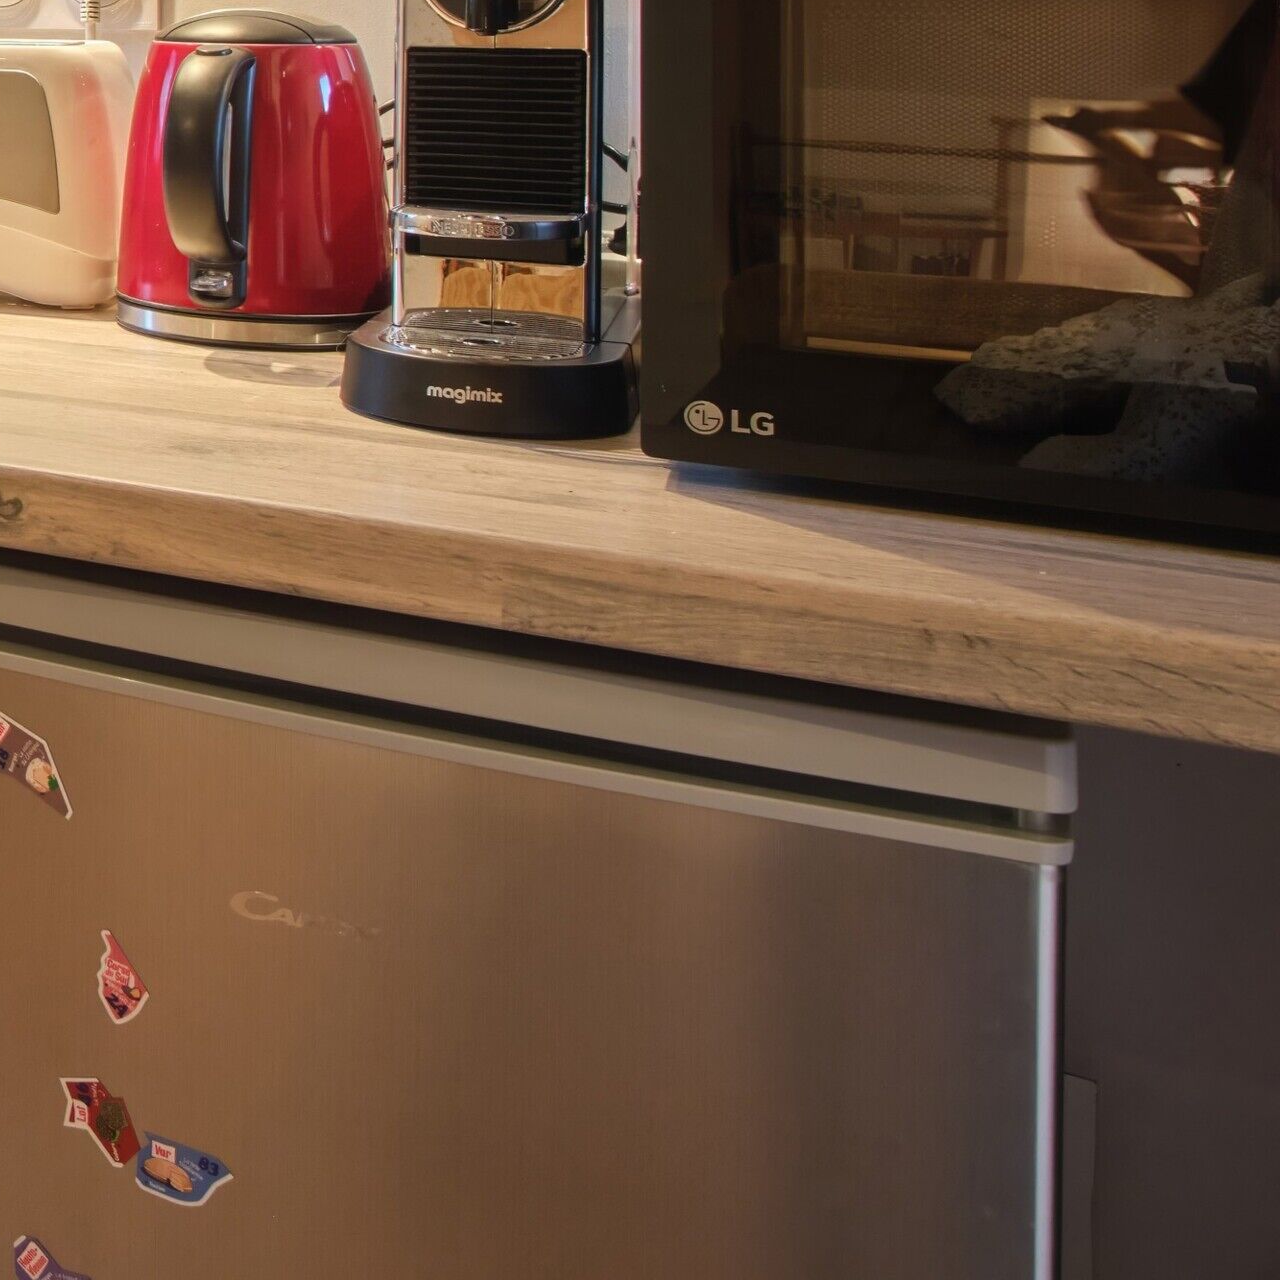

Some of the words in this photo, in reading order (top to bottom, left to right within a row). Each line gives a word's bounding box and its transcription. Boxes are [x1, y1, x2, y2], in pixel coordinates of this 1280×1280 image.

[426, 385, 503, 404] magimix
[731, 409, 775, 436] LG
[154, 1143, 172, 1159] Var
[198, 1155, 219, 1177] 83
